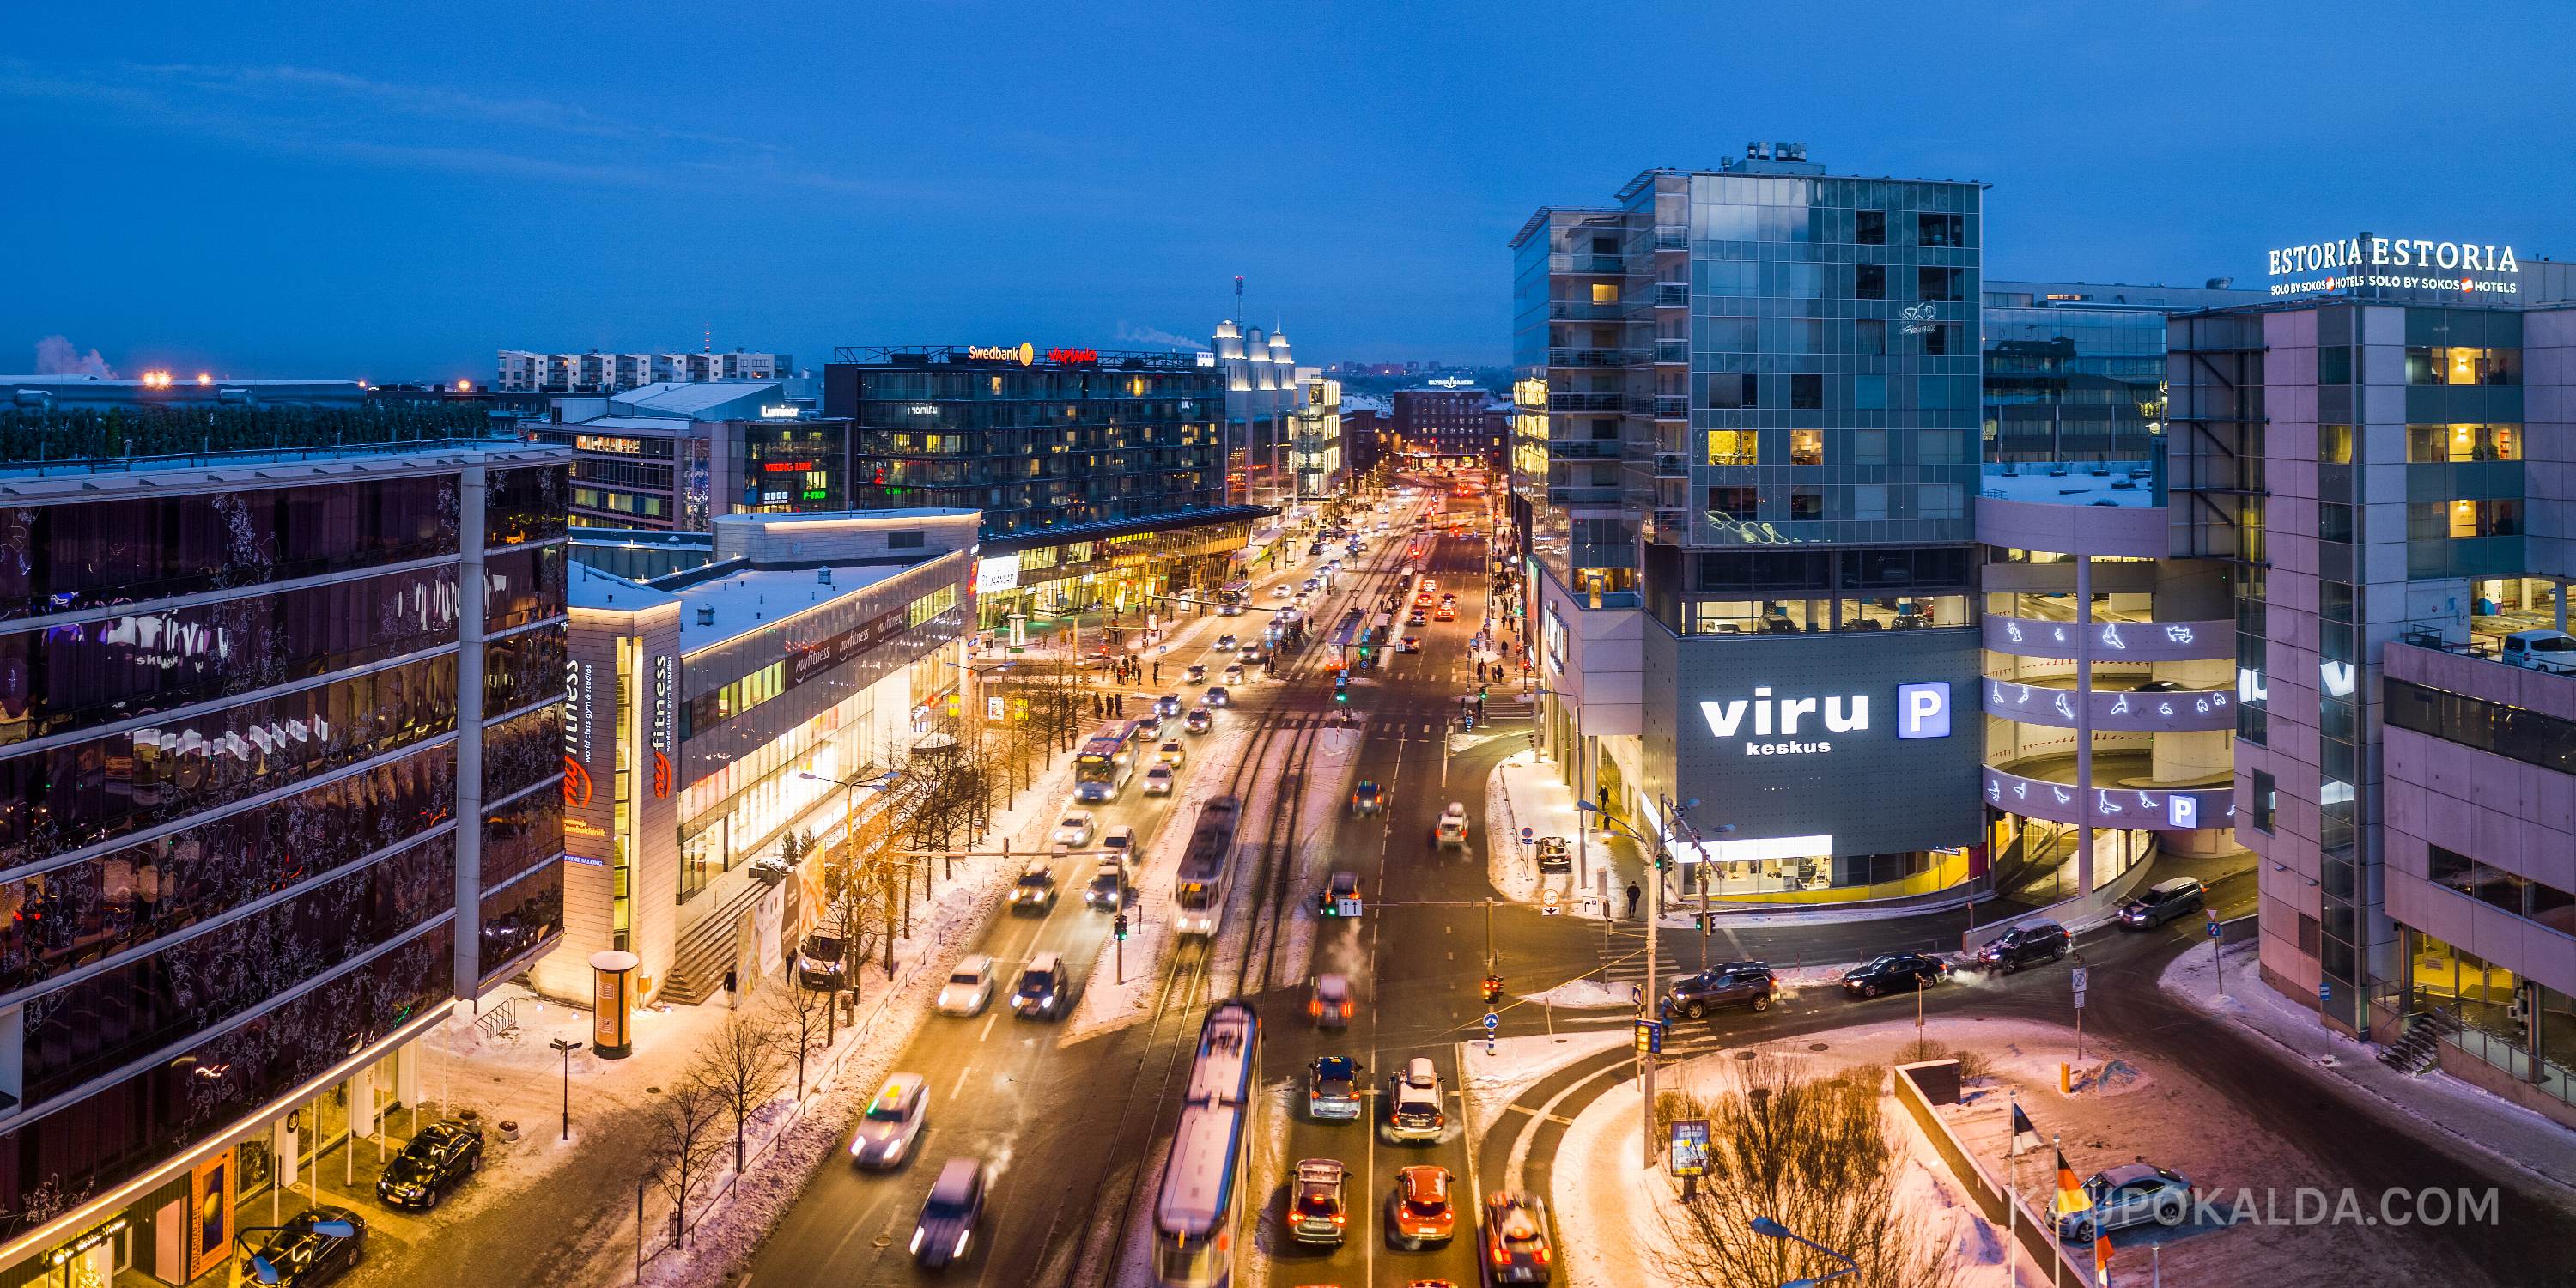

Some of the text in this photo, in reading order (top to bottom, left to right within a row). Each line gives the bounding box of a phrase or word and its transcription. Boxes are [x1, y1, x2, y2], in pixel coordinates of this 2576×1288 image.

[2269, 238, 2362, 276] ESTORIA
[2371, 237, 2519, 273] ESTORIA
[2271, 275, 2364, 295] SOLO BY SOKOS HOTELS
[2368, 276, 2517, 294] SOLO BY SOKOS HOTELS
[969, 345, 1020, 361] Swedbank
[762, 405, 799, 417] Luminor
[764, 462, 812, 471] VIKING LINE
[795, 647, 829, 683] myfitness
[1700, 687, 1868, 737] viru
[1747, 740, 1832, 756] keskus
